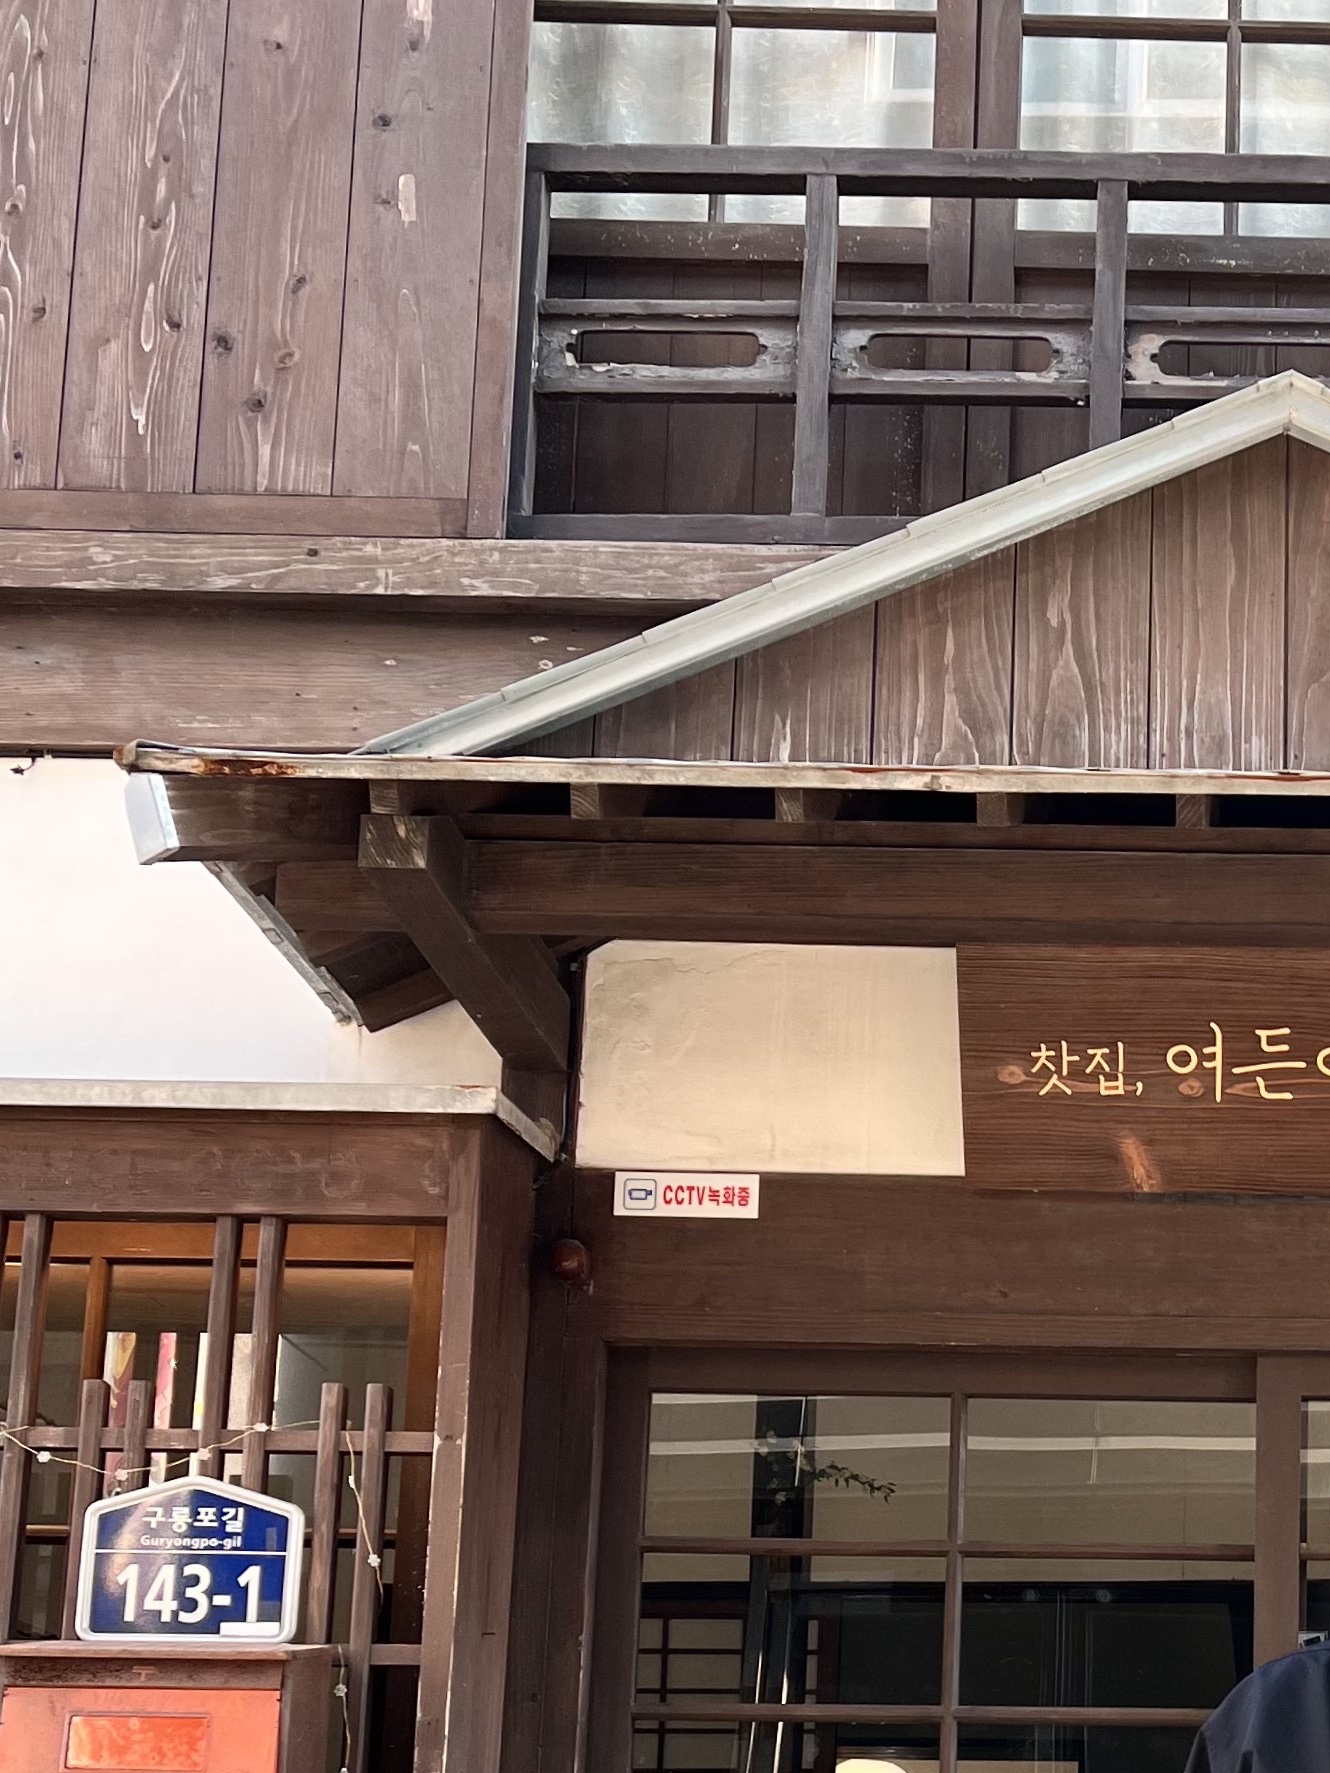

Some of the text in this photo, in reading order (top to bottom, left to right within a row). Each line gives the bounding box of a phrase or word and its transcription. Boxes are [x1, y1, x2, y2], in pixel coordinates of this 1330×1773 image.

[1030, 1040, 1145, 1097] 찻집,
[141, 1506, 245, 1533] 구룡포길
[140, 1534, 242, 1550] Guryongpo-gil
[115, 1563, 262, 1624] 143-1
